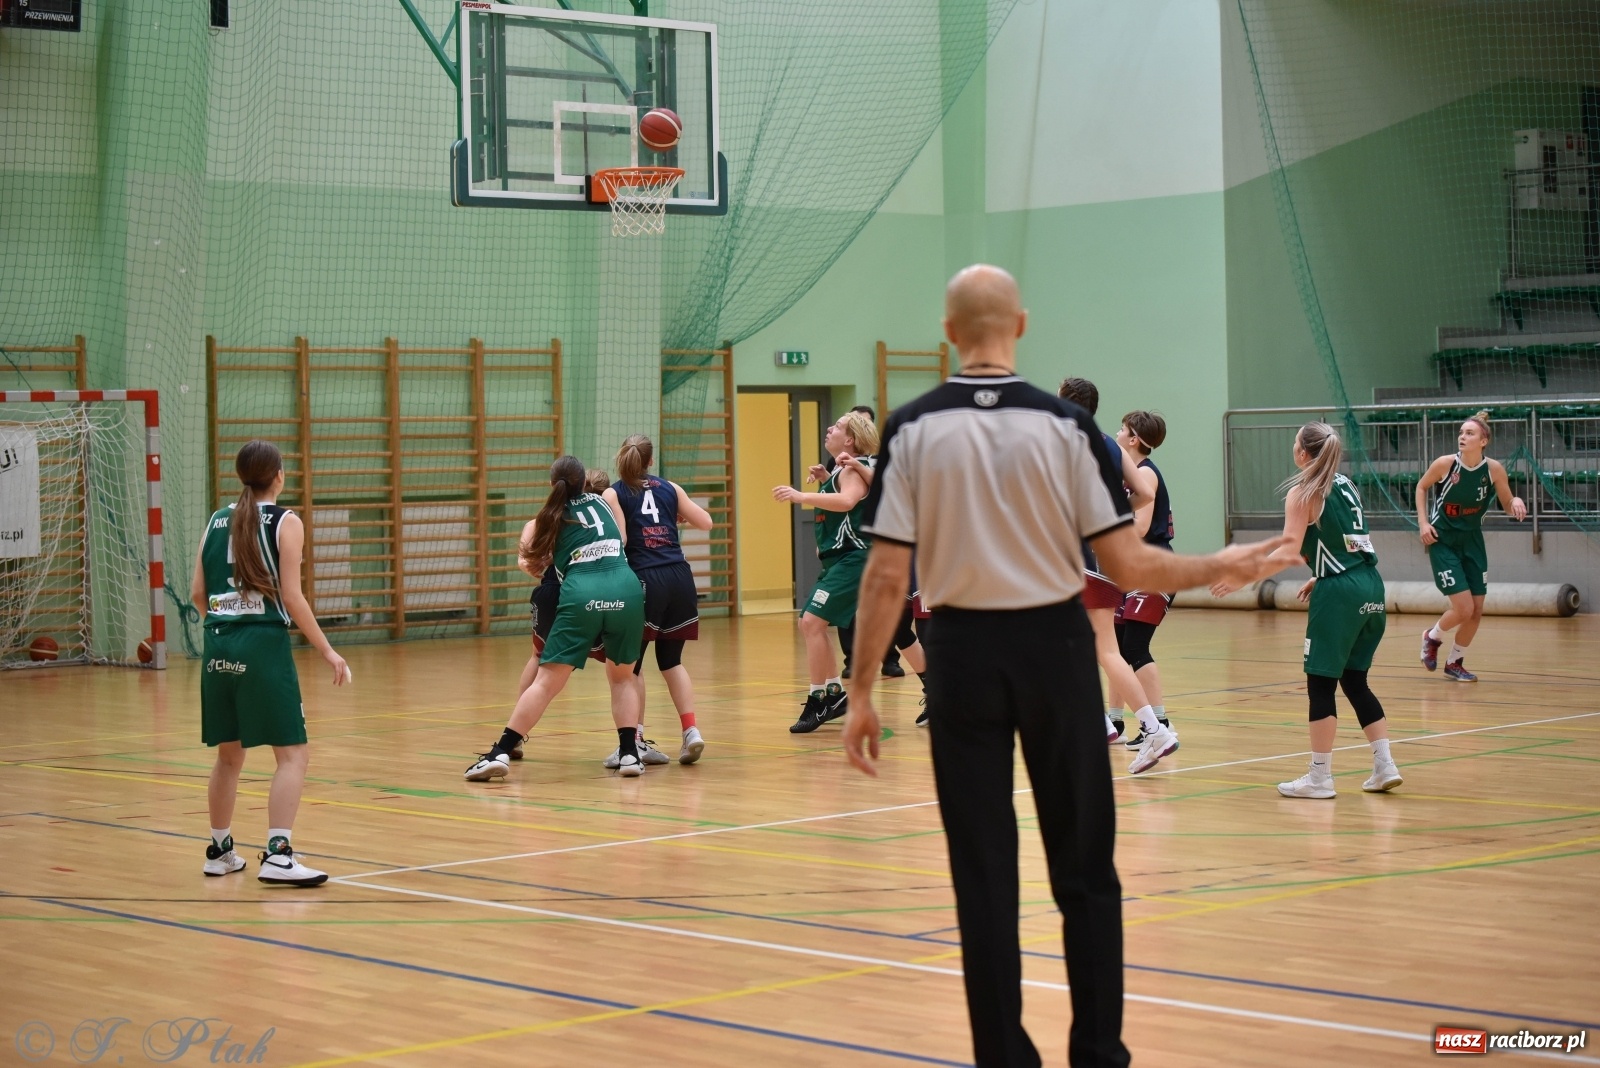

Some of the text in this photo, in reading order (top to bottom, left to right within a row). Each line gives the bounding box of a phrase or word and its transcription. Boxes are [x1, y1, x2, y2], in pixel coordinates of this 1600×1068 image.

[25, 11, 74, 22] PRZEWINIENIA
[641, 489, 660, 524] 4
[213, 516, 229, 529] RKK
[576, 505, 605, 536] 4
[1438, 569, 1456, 588] 35
[594, 599, 625, 609] Clavis
[1134, 597, 1145, 614] 7
[215, 659, 247, 672] Clavis
